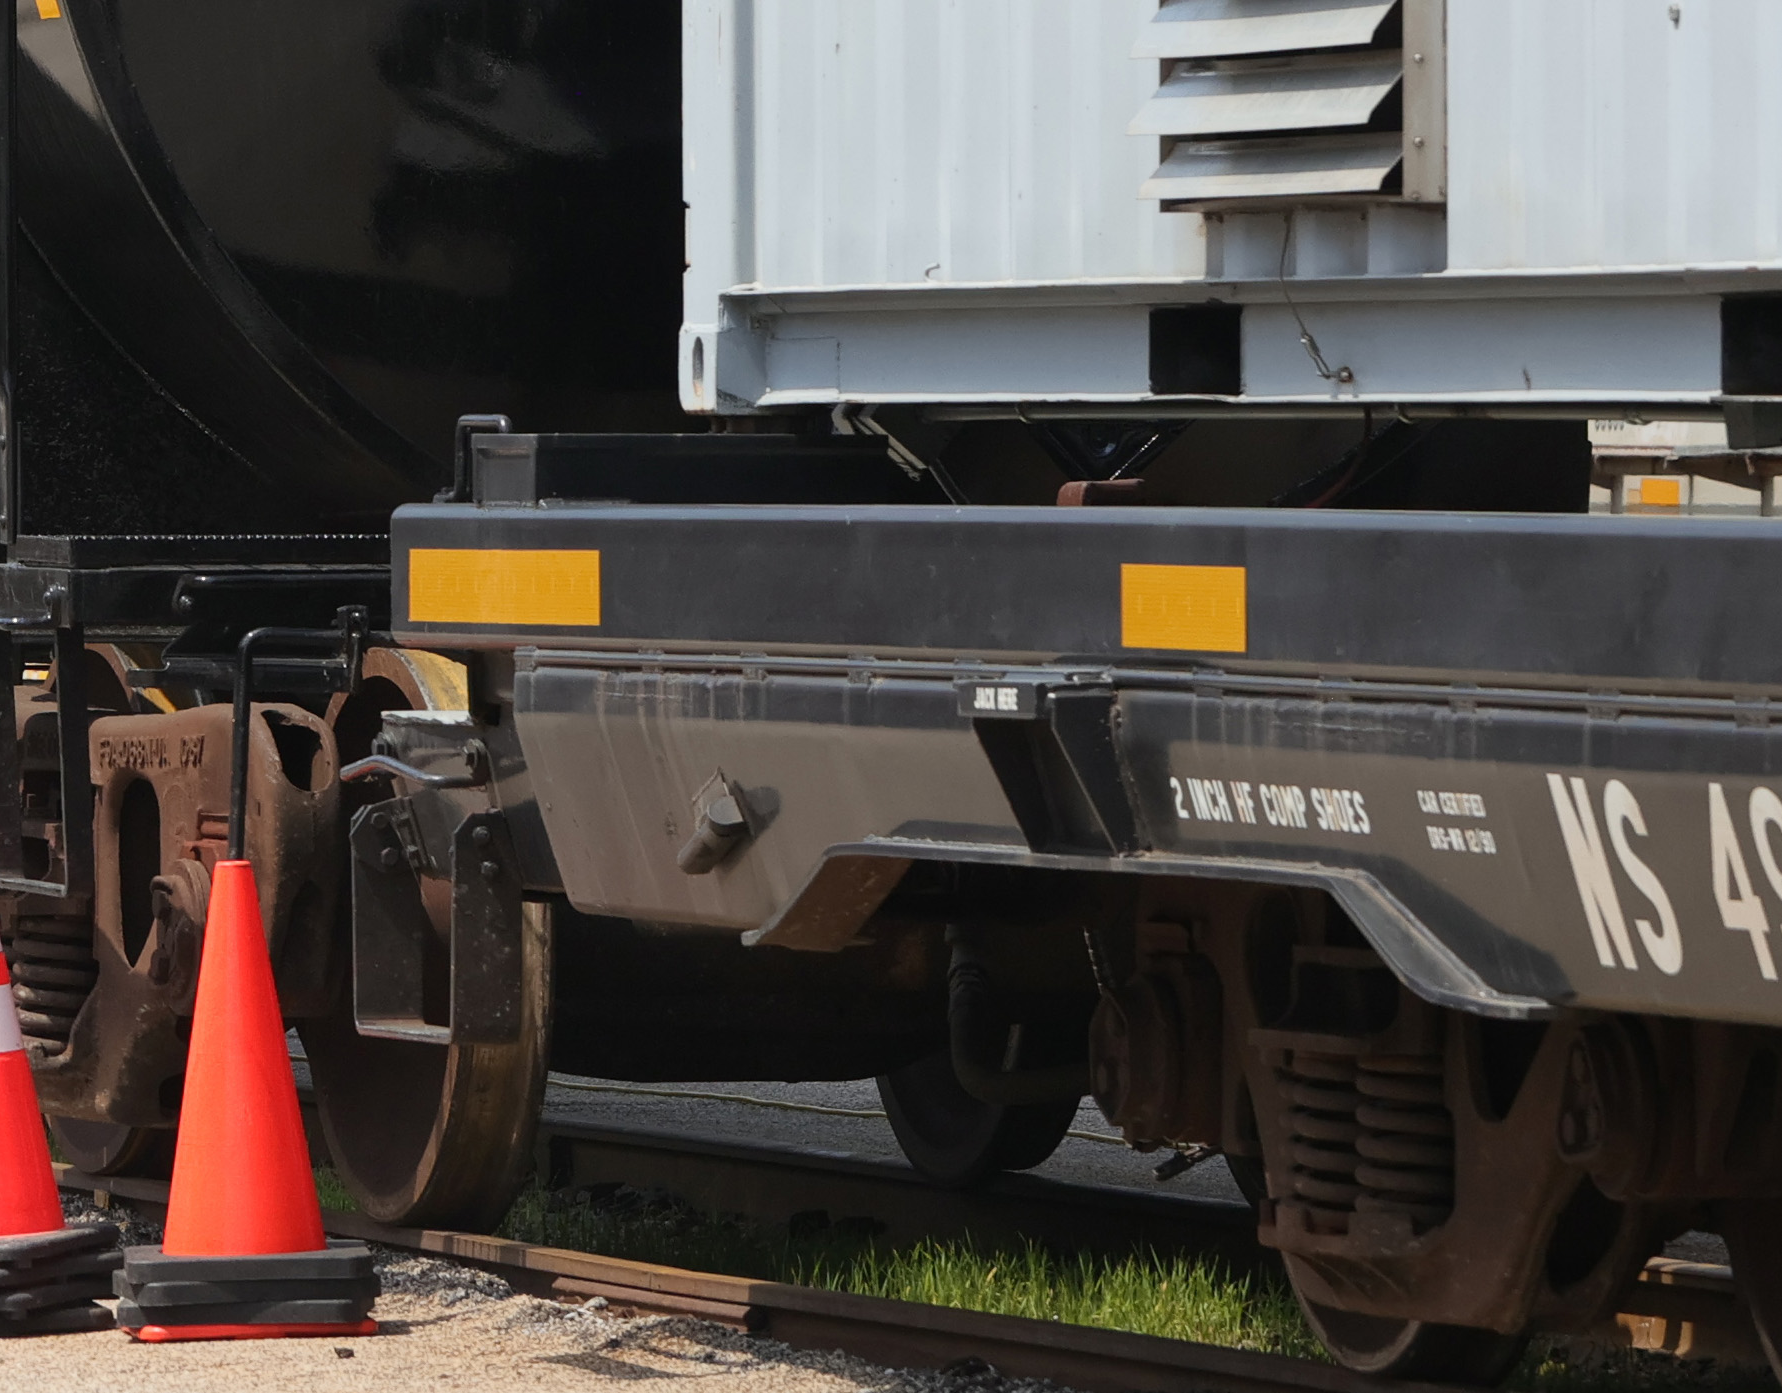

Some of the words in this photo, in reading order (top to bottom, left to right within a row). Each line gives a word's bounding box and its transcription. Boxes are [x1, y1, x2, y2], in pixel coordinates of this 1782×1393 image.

[1169, 776, 1189, 819] 2
[1187, 777, 1233, 823] INCH
[1229, 781, 1256, 825] HF
[1259, 783, 1308, 829] COMP
[1310, 787, 1371, 835] SHOES
[1416, 790, 1439, 814] CAR
[1546, 773, 1683, 976] NS
